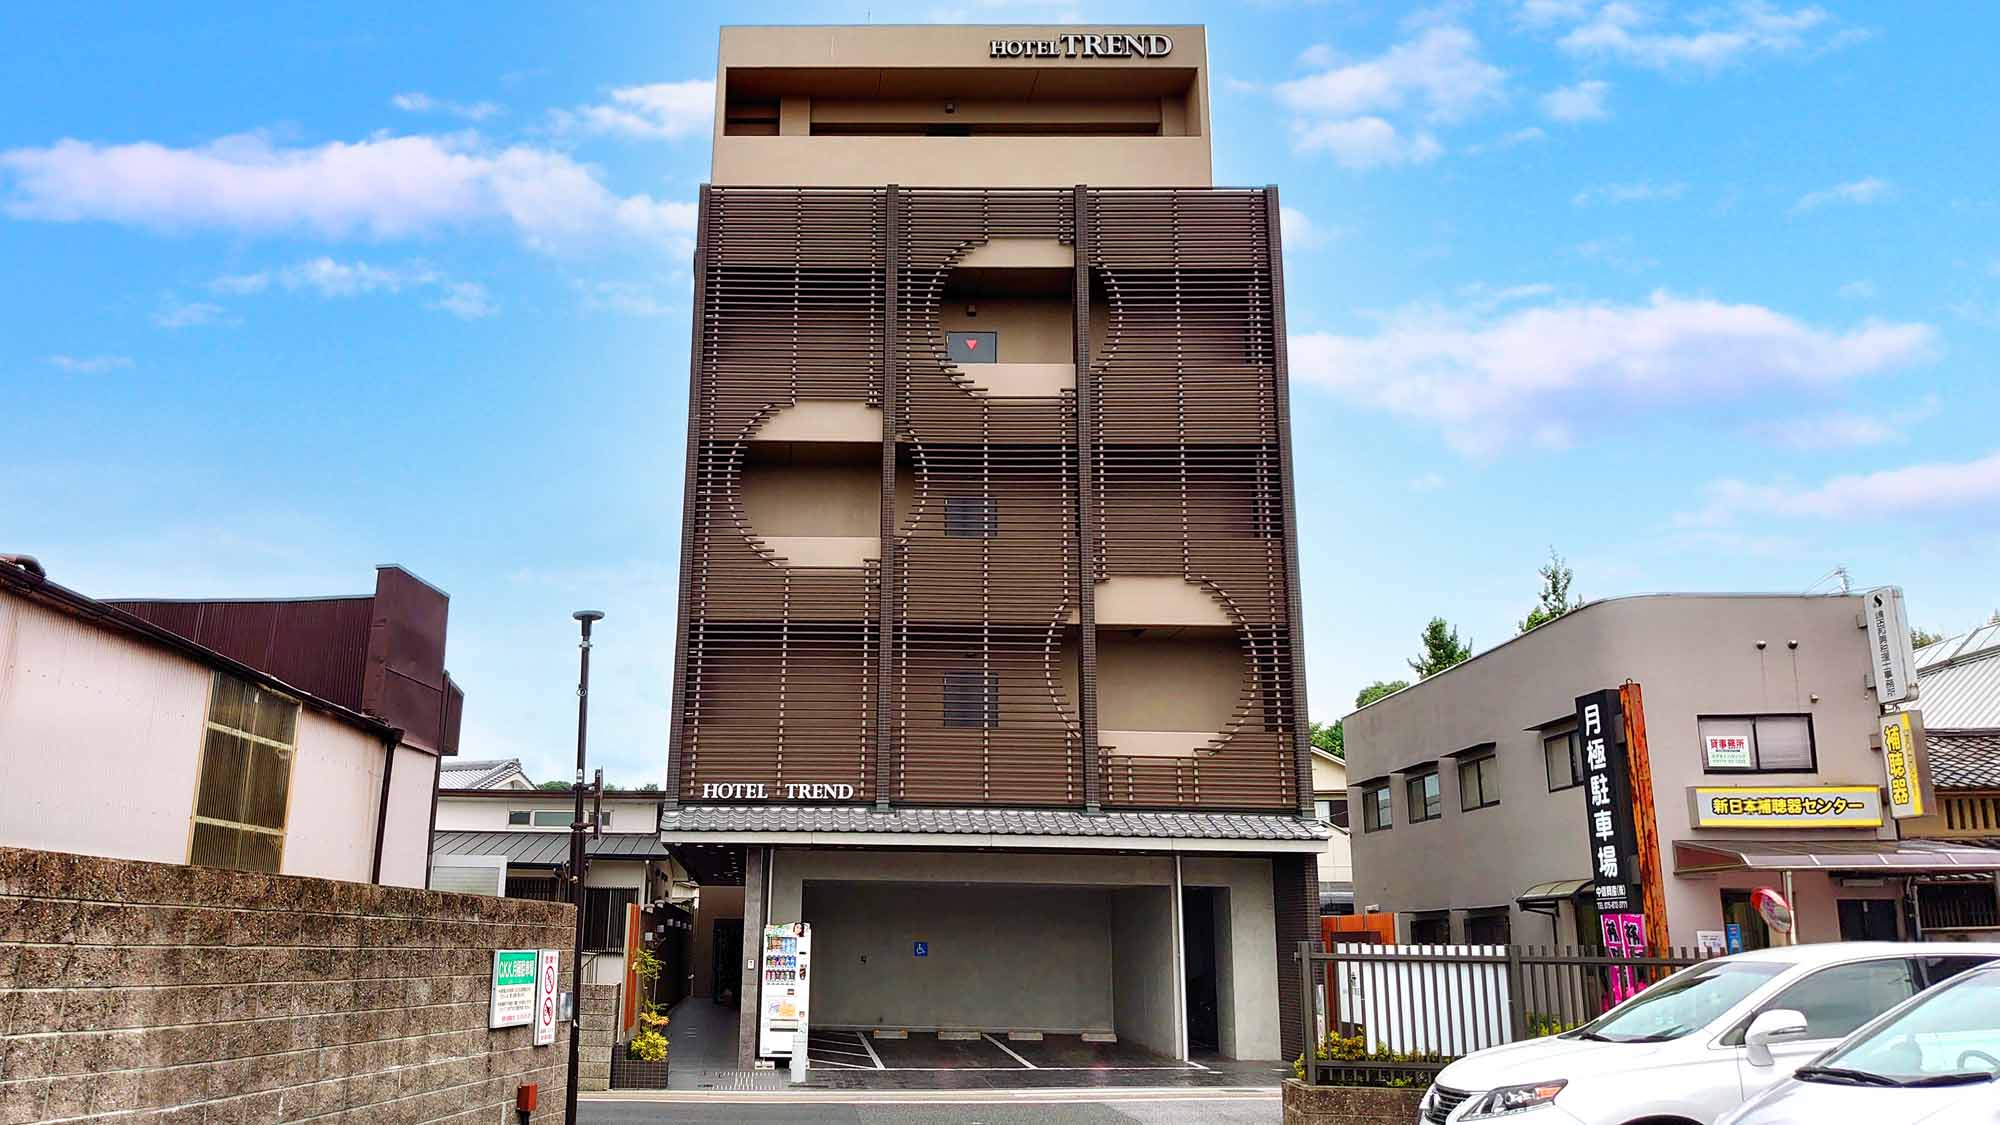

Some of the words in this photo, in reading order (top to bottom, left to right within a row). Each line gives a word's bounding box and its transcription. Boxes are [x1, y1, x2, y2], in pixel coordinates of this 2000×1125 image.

[990, 40, 1060, 58] HOTEL
[1060, 33, 1173, 58] TREND
[1884, 723, 1909, 805] 補聴器
[702, 783, 768, 799] HOTEL
[785, 783, 854, 799] TREND
[1583, 702, 1618, 878] 月極駐車場
[1712, 797, 1864, 816] 新日本補聴器センター
